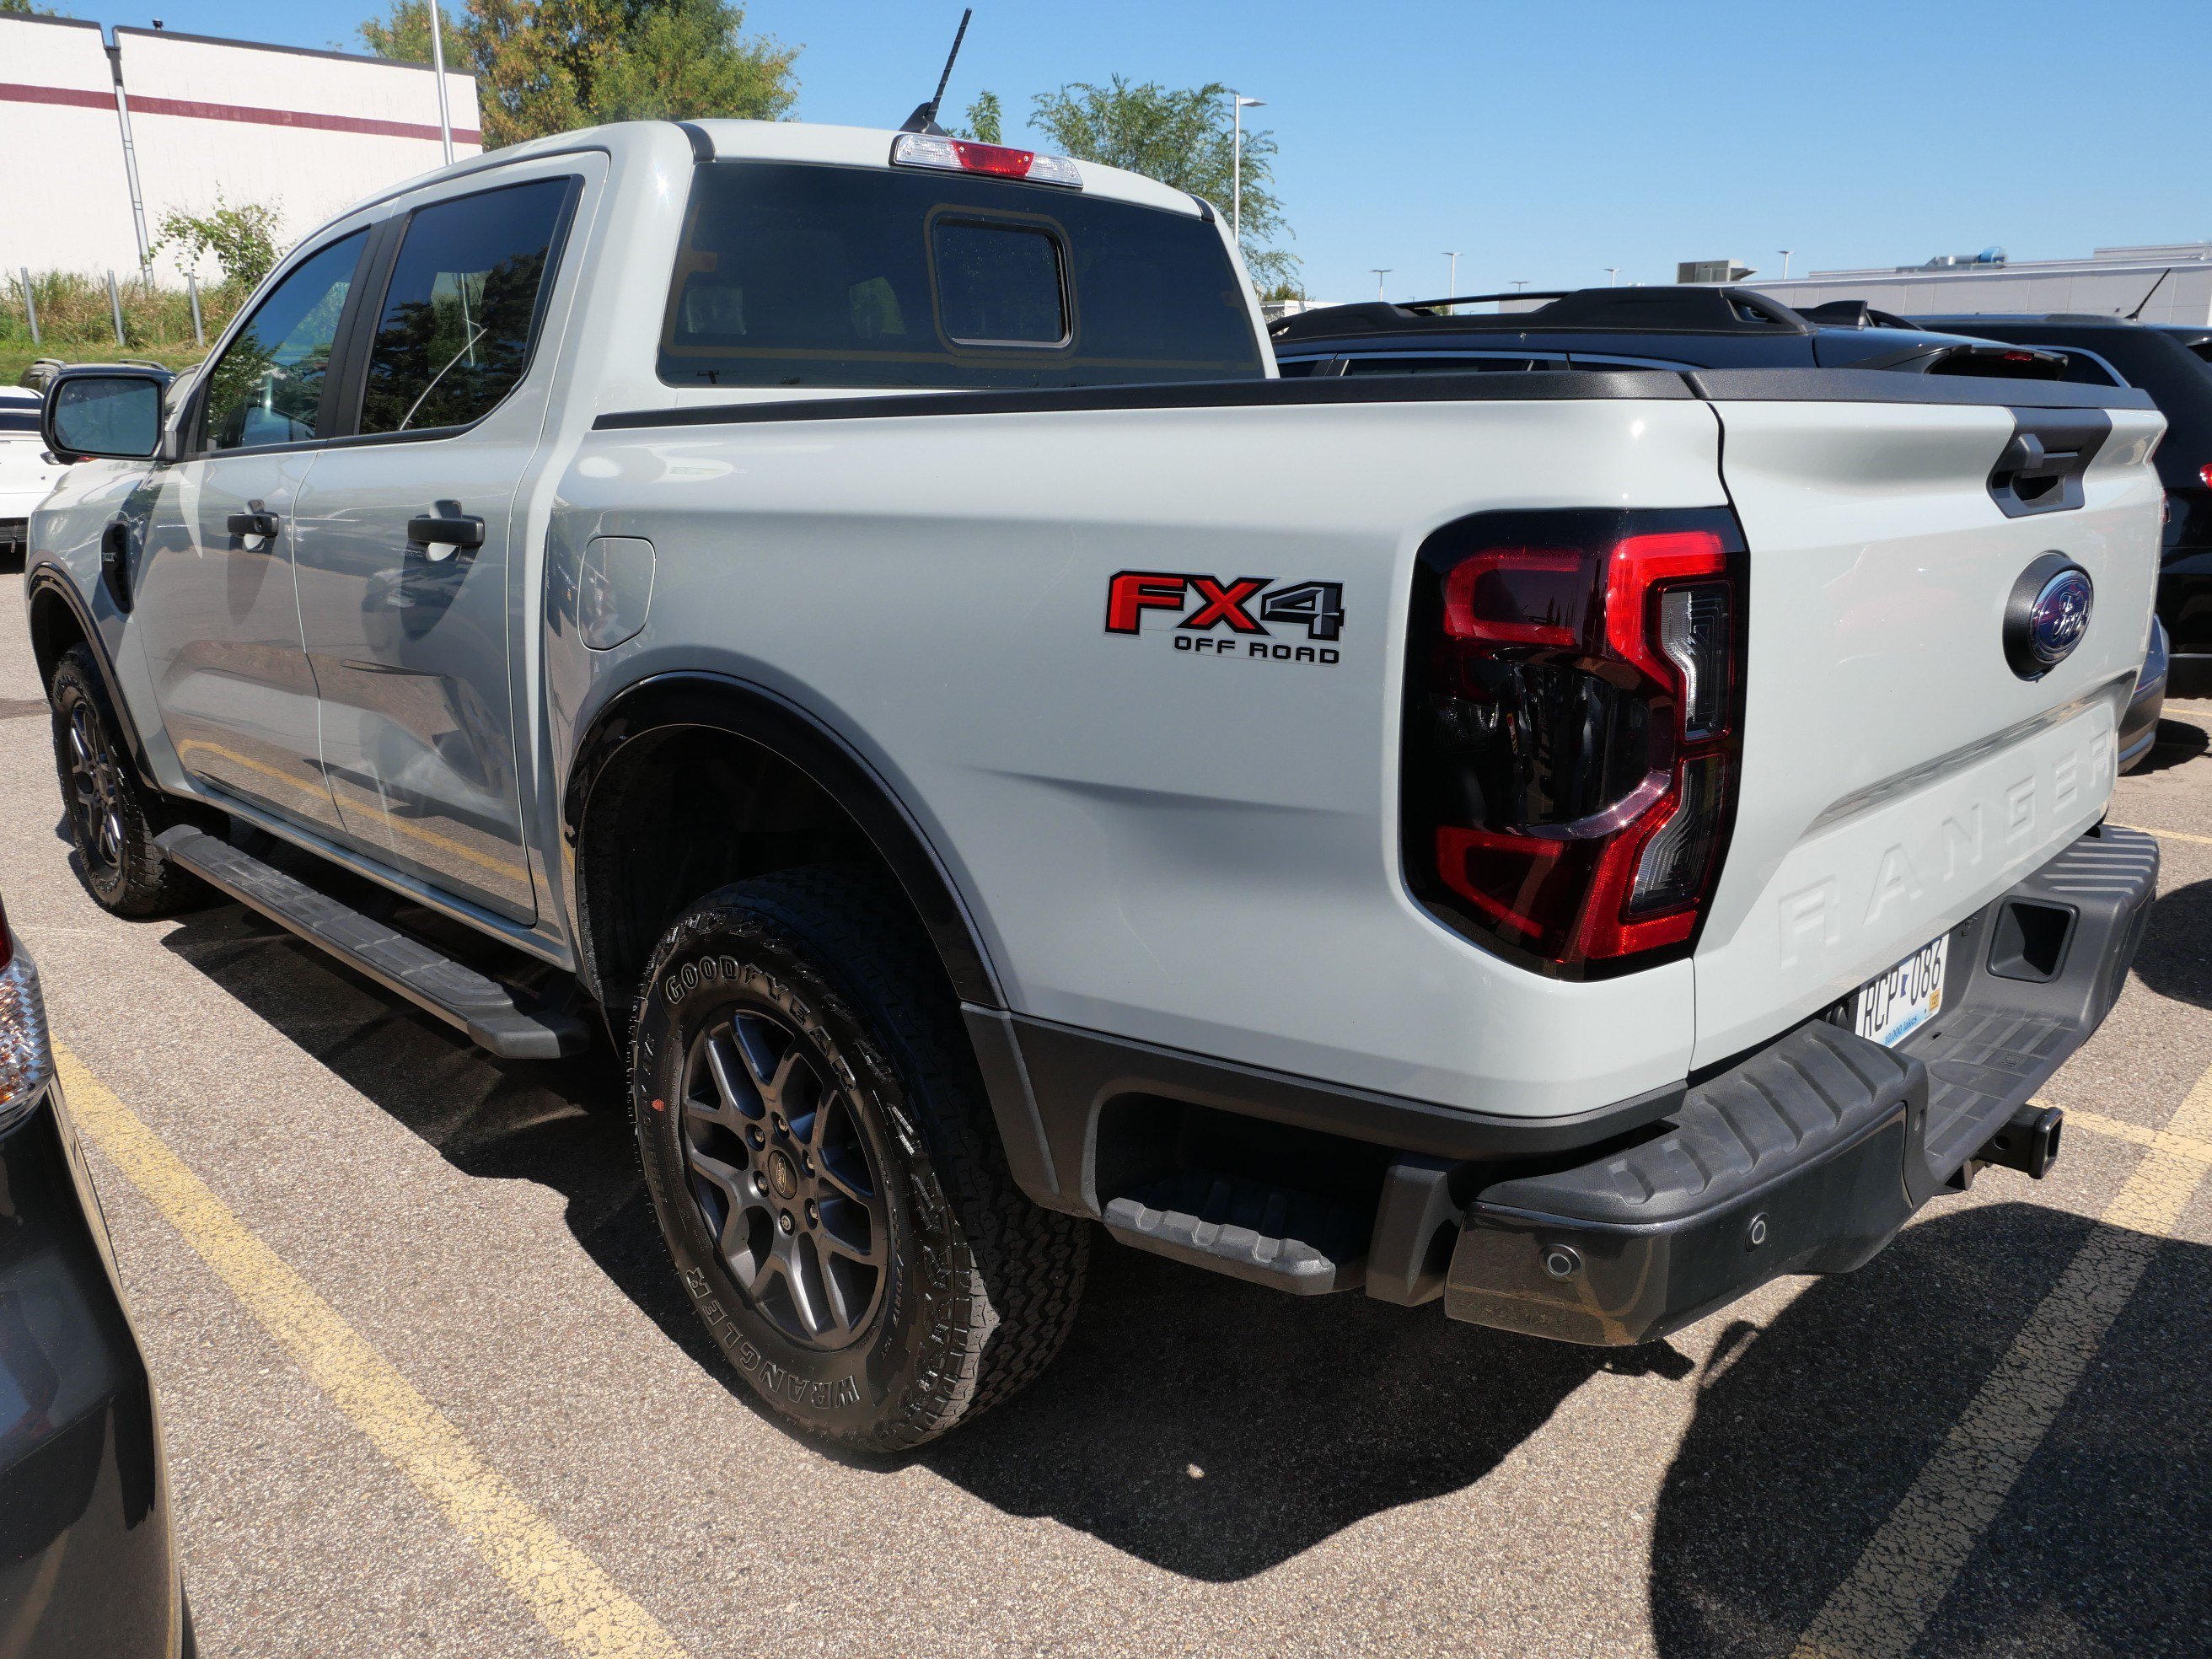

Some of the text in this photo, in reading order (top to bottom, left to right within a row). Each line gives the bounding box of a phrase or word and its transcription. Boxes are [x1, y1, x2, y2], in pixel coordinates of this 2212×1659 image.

[1105, 570, 1345, 642] FX4
[1174, 636, 1340, 664] OFF ROAD
[1778, 729, 2108, 969] RANGER
[665, 955, 856, 1093] GOODYEAR
[1863, 937, 1943, 1039] RCP 086
[1884, 1015, 1918, 1045] 10,000 lakes
[685, 1266, 861, 1409] WRANGLER
